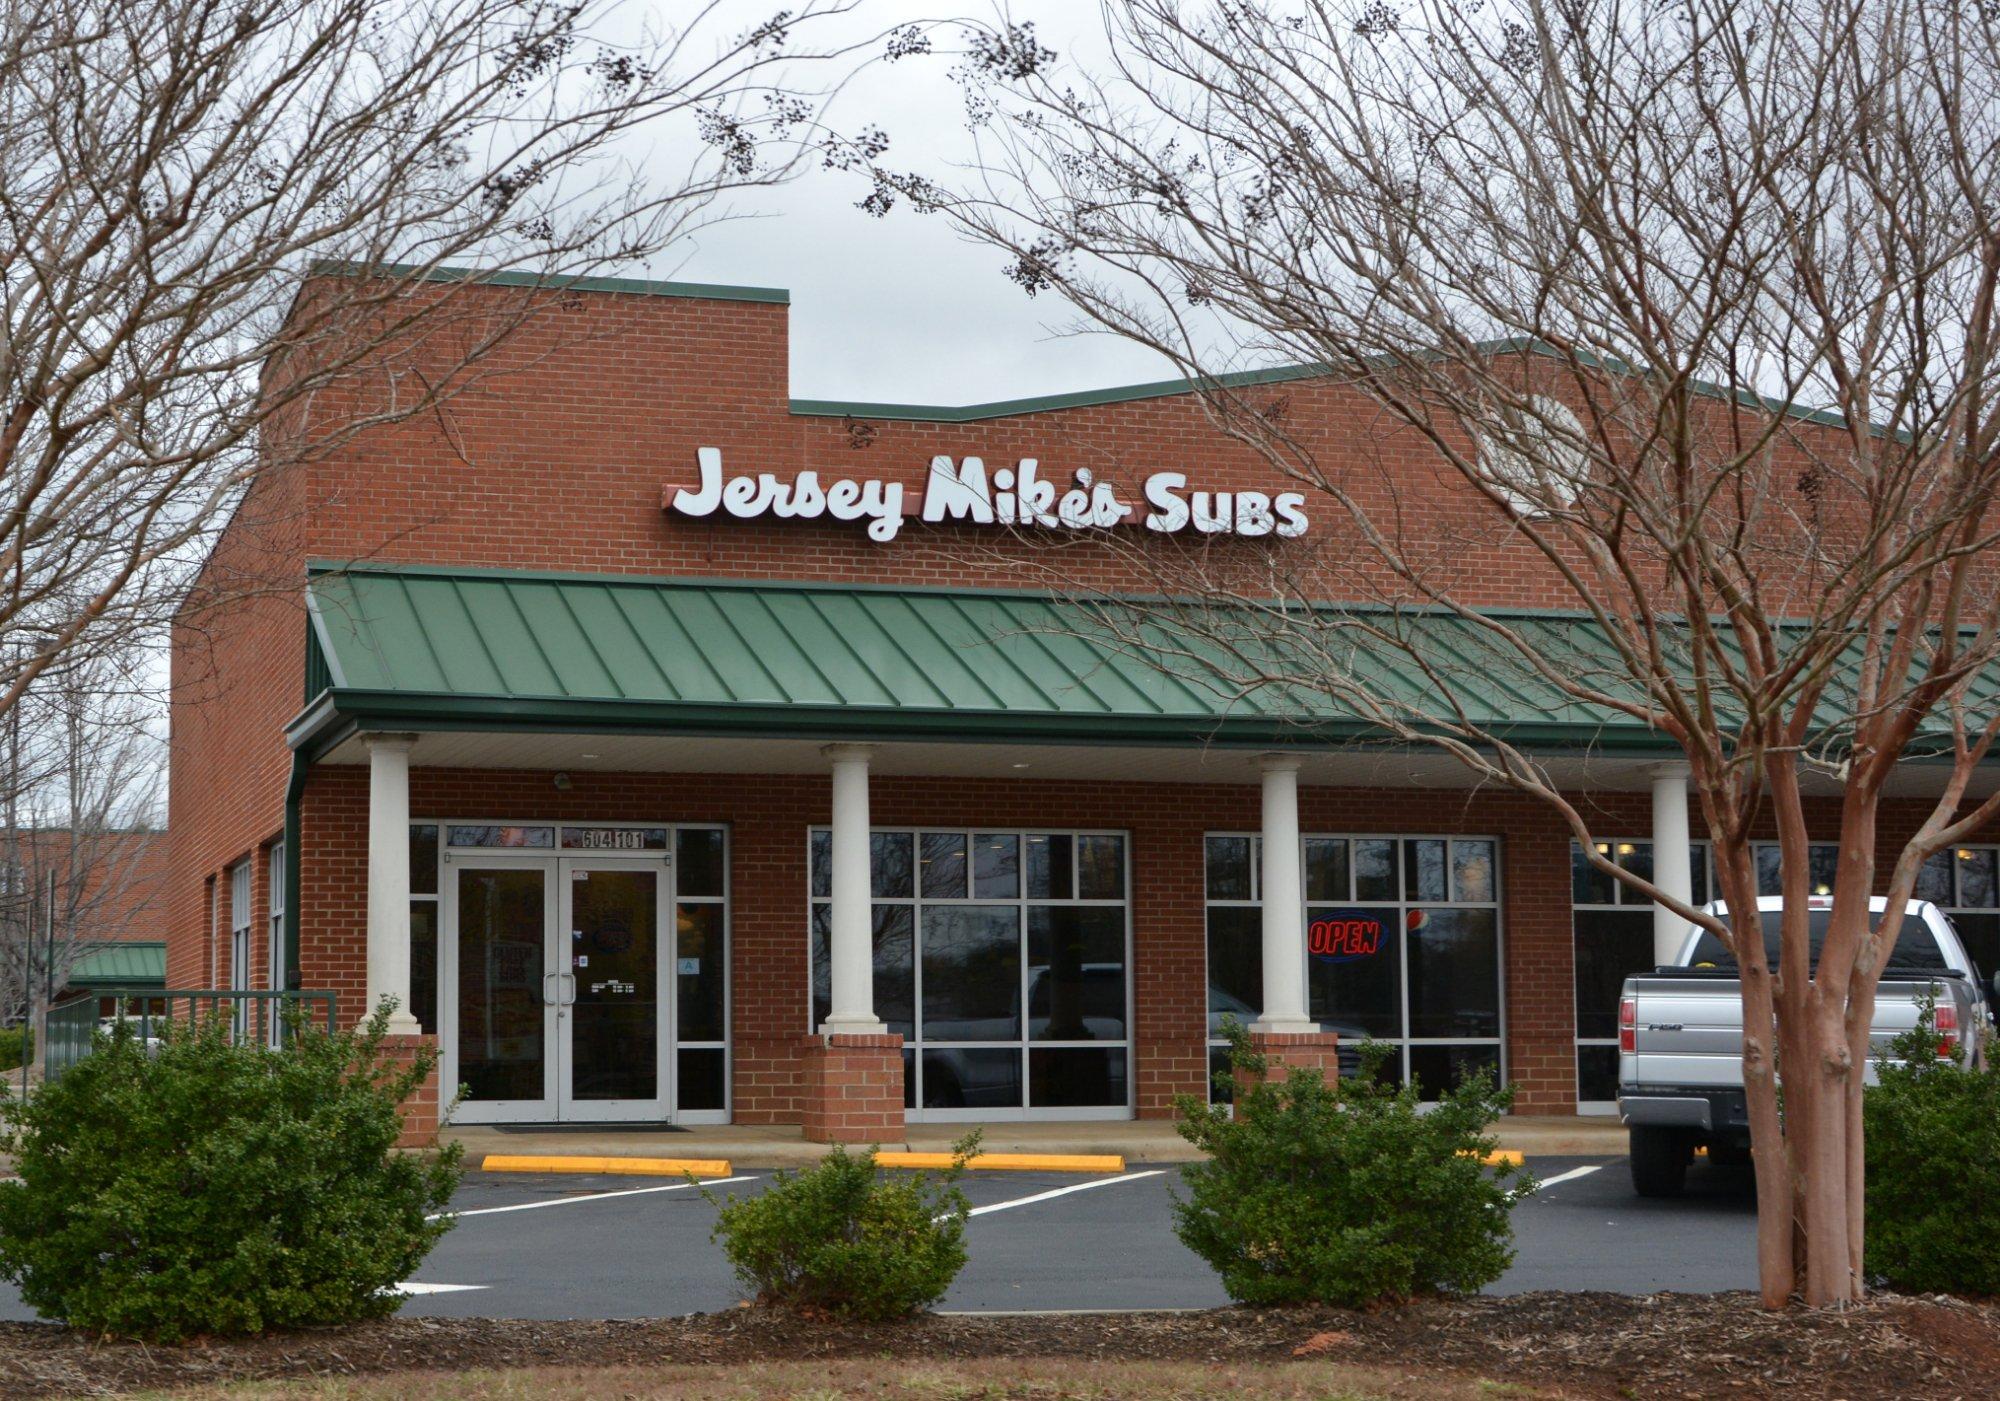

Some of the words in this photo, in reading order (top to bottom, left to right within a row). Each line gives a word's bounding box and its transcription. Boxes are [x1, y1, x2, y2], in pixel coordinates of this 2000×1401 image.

[674, 447, 904, 543] Jersey
[922, 455, 1132, 530] Mike's
[1308, 920, 1379, 954] OPEN
